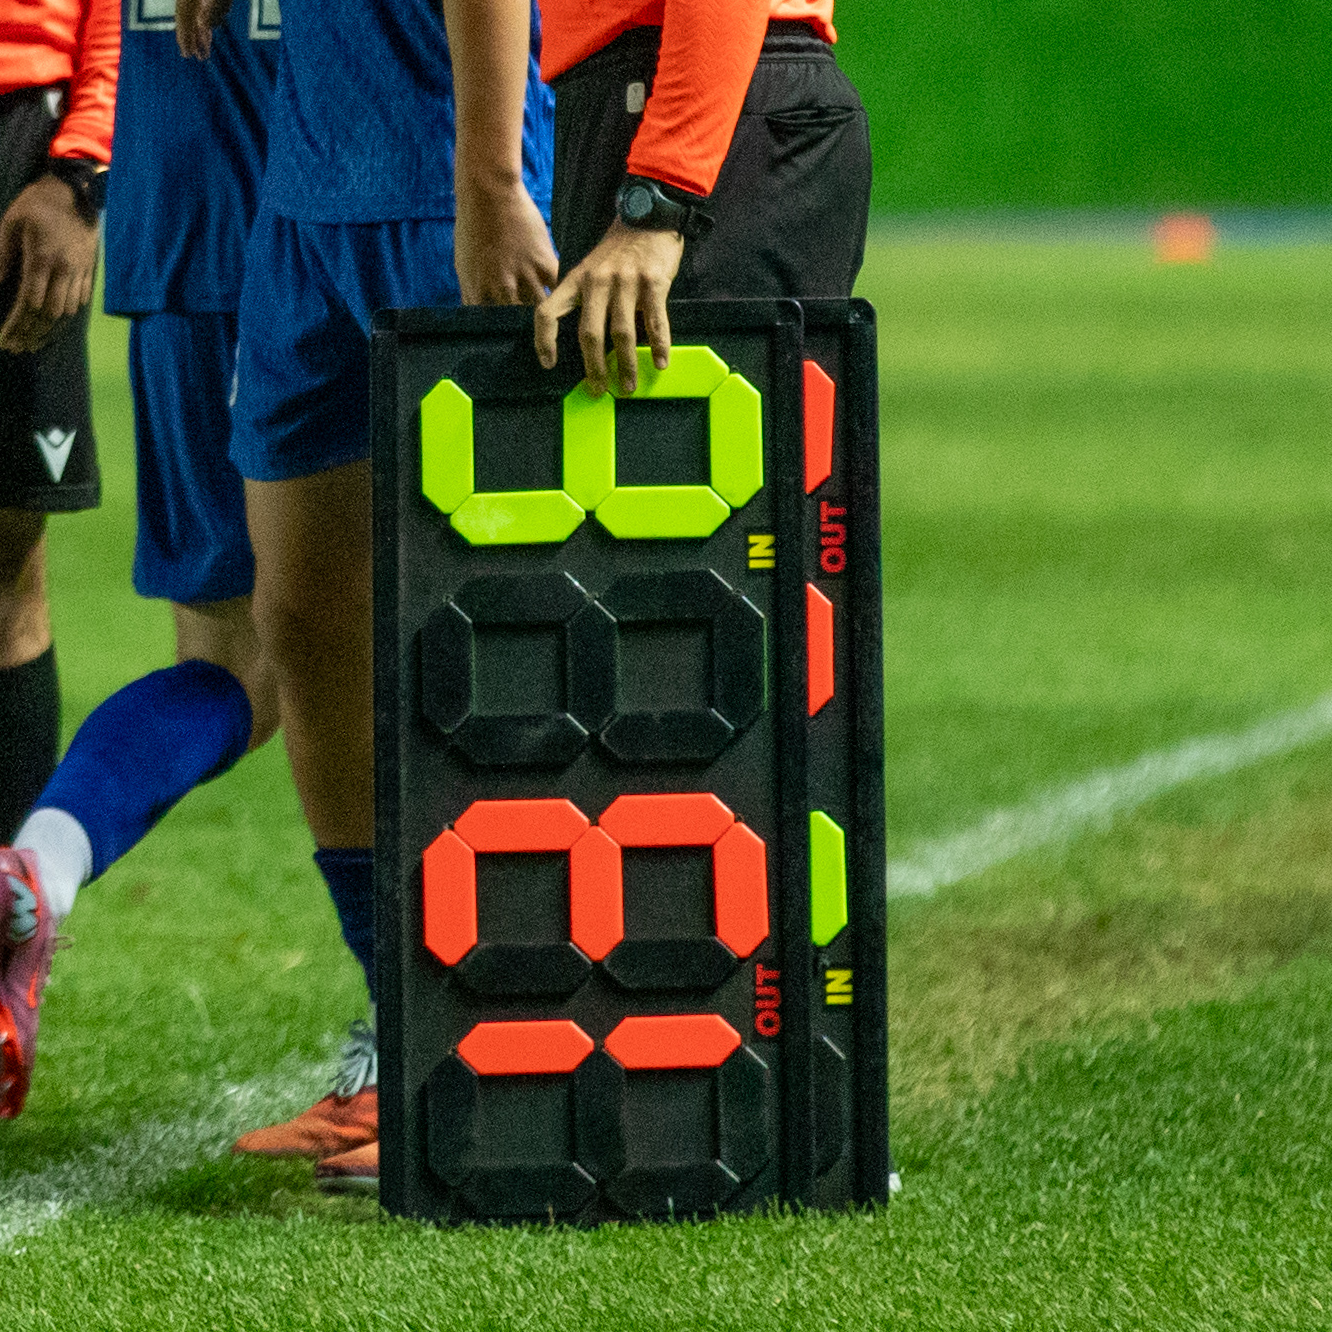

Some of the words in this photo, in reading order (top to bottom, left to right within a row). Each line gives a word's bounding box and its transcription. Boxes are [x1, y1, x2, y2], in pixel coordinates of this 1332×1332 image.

[747, 534, 776, 570] IN
[819, 500, 847, 573] OUT
[423, 792, 769, 1076] 13
[754, 963, 781, 1037] OUT
[825, 968, 854, 1005] IN
